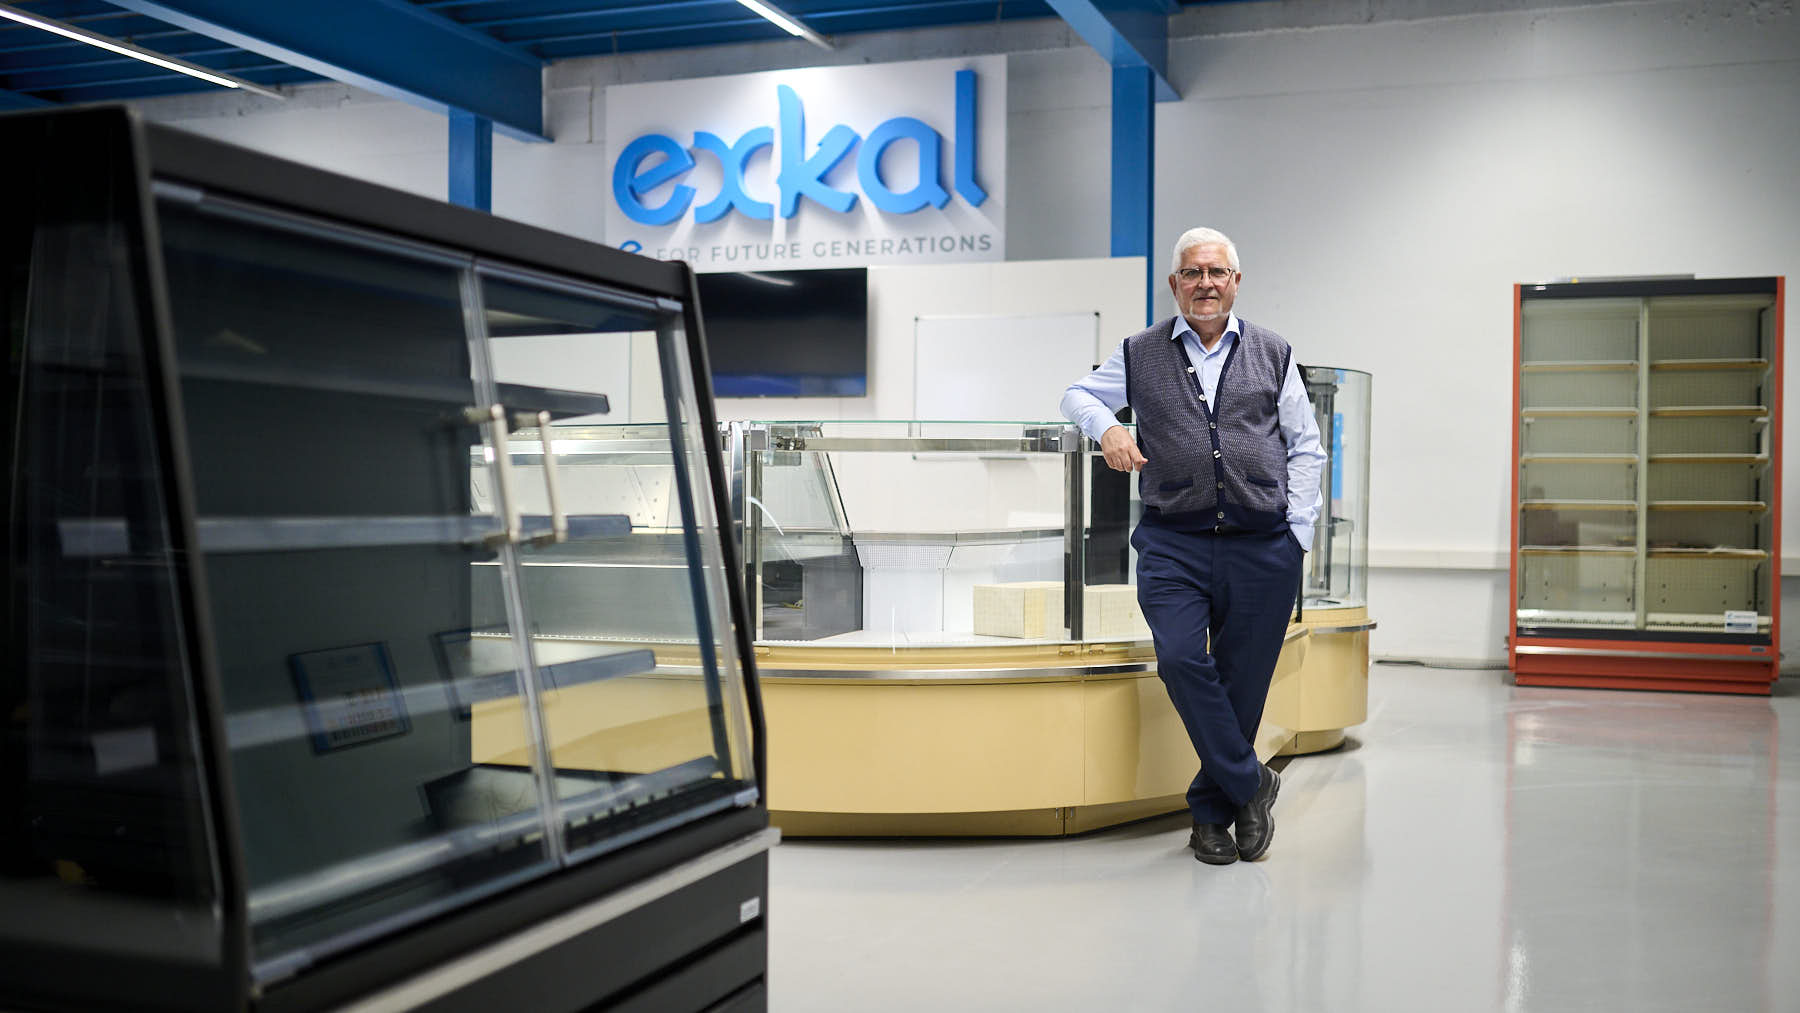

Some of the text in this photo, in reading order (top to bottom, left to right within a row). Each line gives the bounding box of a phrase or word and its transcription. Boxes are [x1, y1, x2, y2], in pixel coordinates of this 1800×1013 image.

[612, 69, 988, 226] exkal
[656, 247, 700, 262] FOR
[711, 242, 801, 262] FUTURE
[812, 234, 992, 258] GENERATIONS
